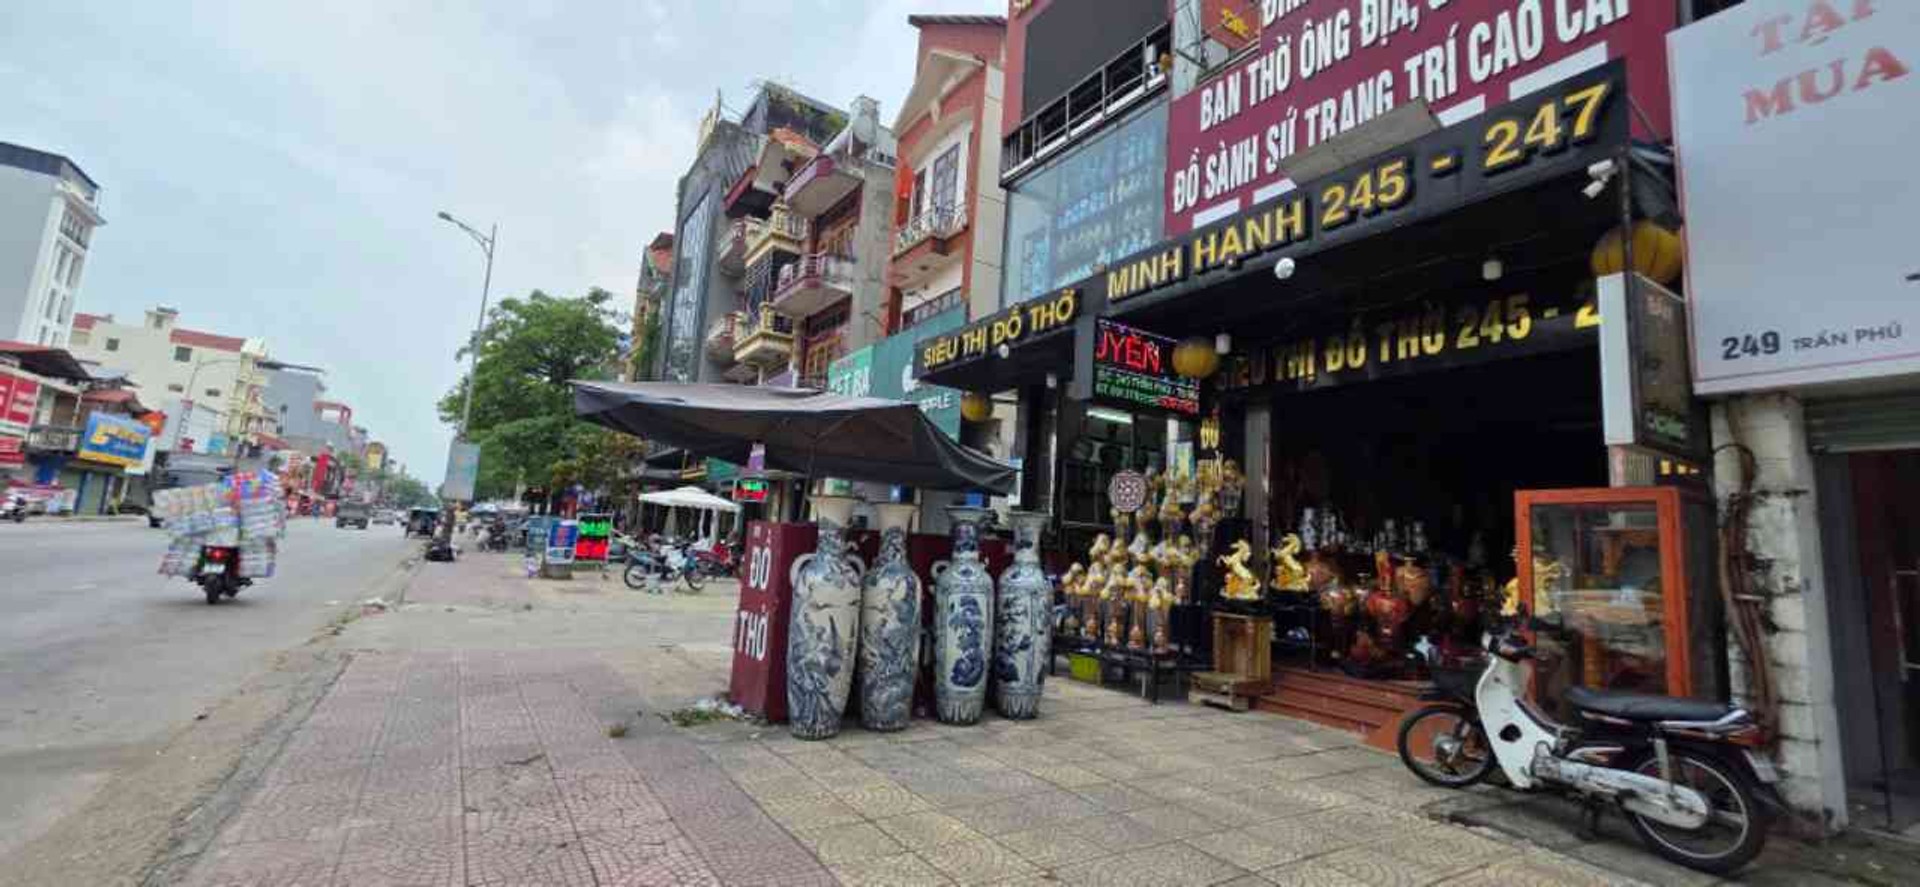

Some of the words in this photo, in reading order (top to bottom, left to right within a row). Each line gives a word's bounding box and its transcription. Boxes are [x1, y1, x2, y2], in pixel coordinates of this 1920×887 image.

[1247, 34, 1292, 106] THỜ
[1300, 9, 1350, 80] ÔNG
[1741, 48, 1910, 124] MUA
[1173, 147, 1200, 214] ĐỒ
[1204, 134, 1259, 200] SÀNH
[1265, 105, 1298, 174] SỨ
[1304, 69, 1394, 147] TRANG
[1404, 21, 1459, 101] TRÍ
[1467, 0, 1544, 83] CAO
[1107, 247, 1182, 297] MINH
[1194, 201, 1303, 272] HẠNH
[1321, 160, 1408, 227] 245
[1484, 82, 1609, 167] 247
[923, 336, 958, 368] SIÊU
[992, 304, 1022, 346] ĐỒ
[1030, 289, 1076, 332] THỜ
[1456, 293, 1532, 350] 245
[1720, 331, 1781, 361] 249
[1854, 321, 1902, 343] PHÚ
